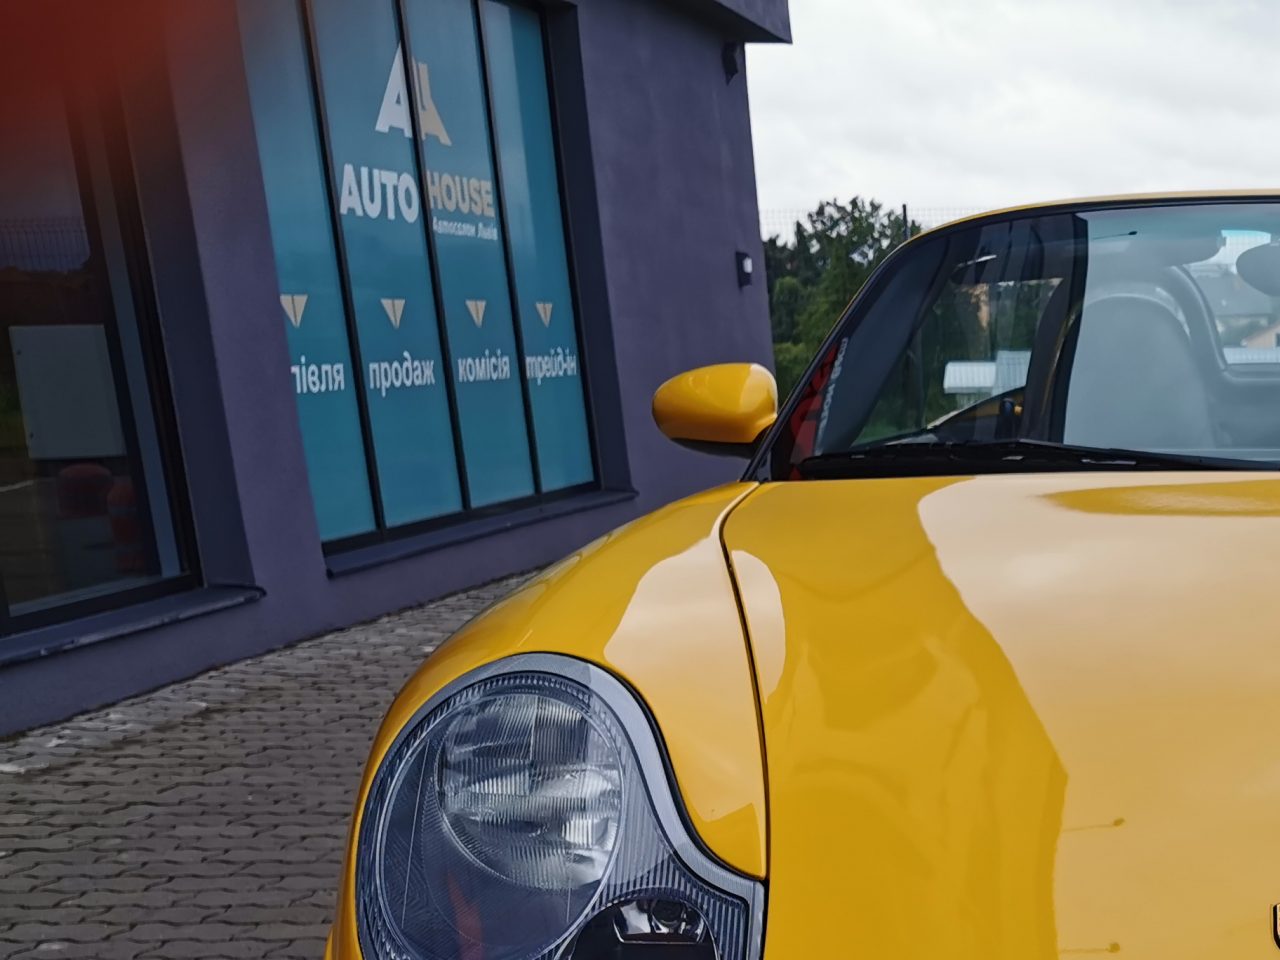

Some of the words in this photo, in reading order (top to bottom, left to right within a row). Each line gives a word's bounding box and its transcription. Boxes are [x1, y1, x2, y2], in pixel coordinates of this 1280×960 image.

[340, 163, 419, 223] AUTO
[426, 170, 495, 218] HOUSE
[369, 350, 435, 397] продаж
[457, 348, 510, 382] комісія
